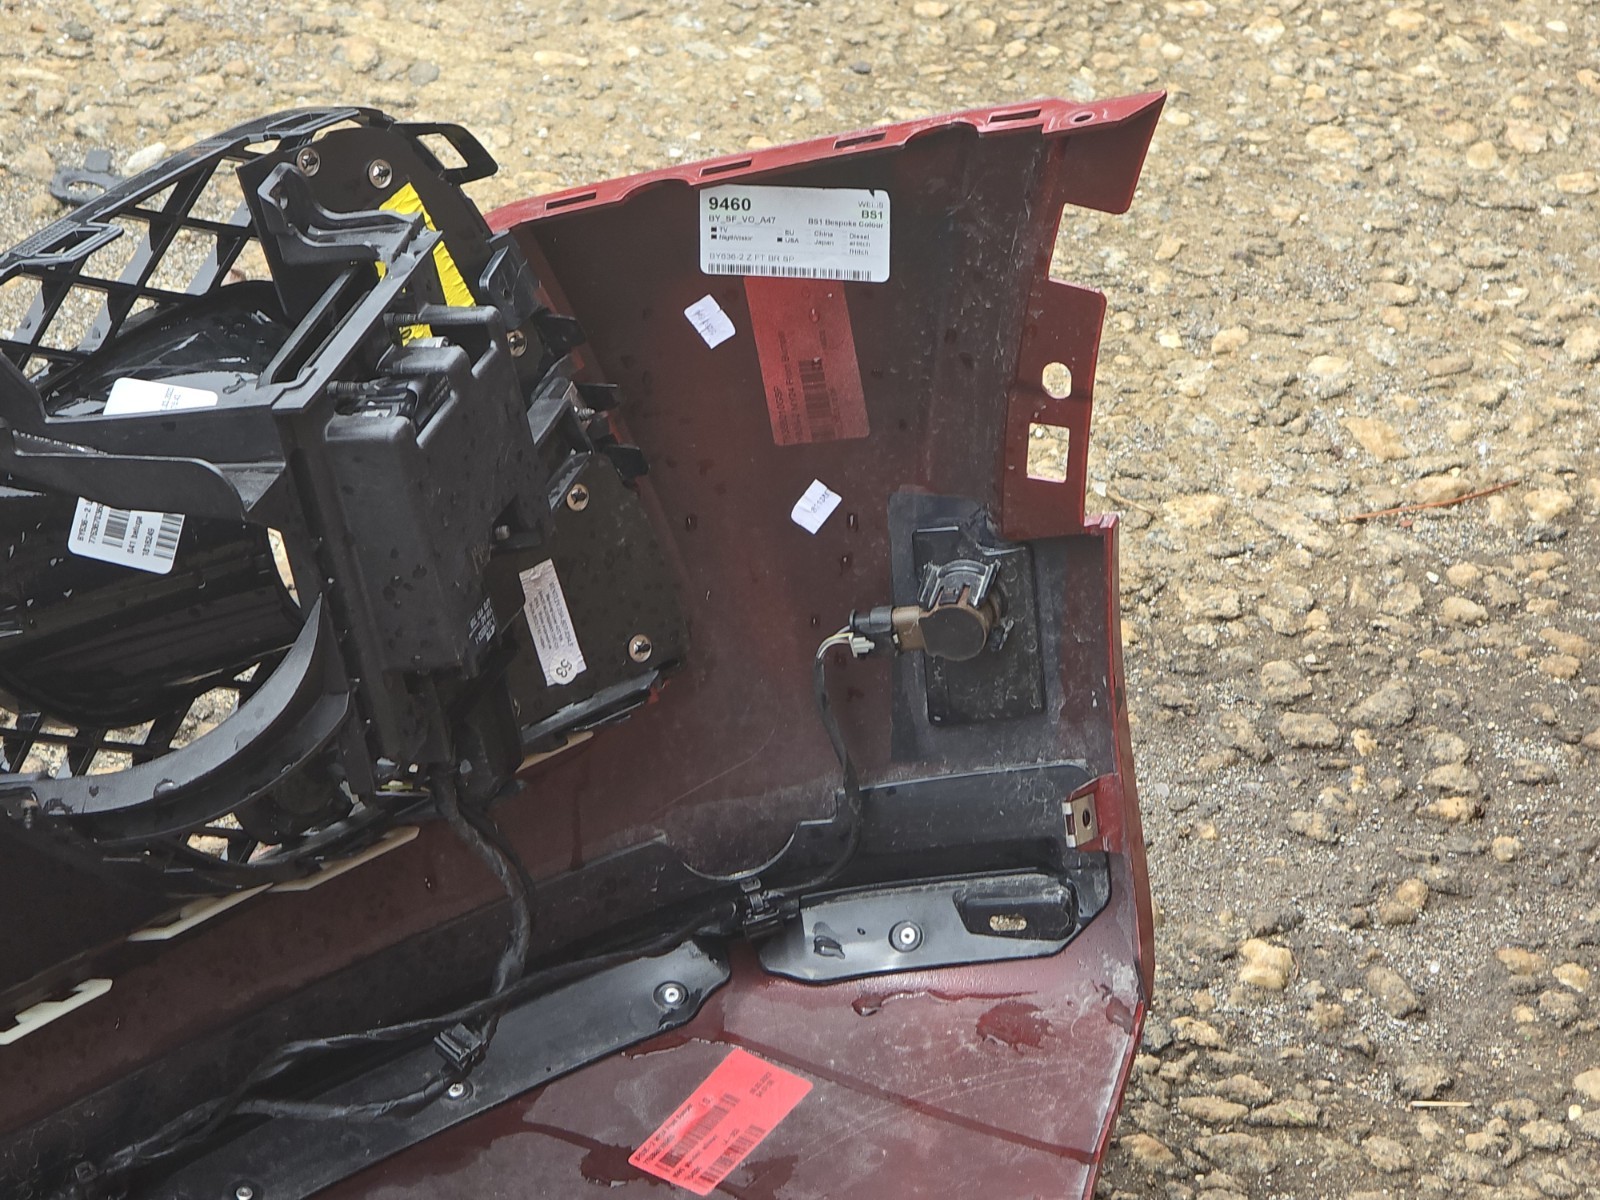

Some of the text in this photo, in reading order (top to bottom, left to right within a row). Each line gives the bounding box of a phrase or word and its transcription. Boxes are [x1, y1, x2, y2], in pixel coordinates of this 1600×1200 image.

[708, 196, 751, 211] 9460
[861, 209, 883, 219] BS1
[825, 219, 857, 228] Bespoke
[858, 221, 884, 229] Colour
[814, 230, 834, 238] China
